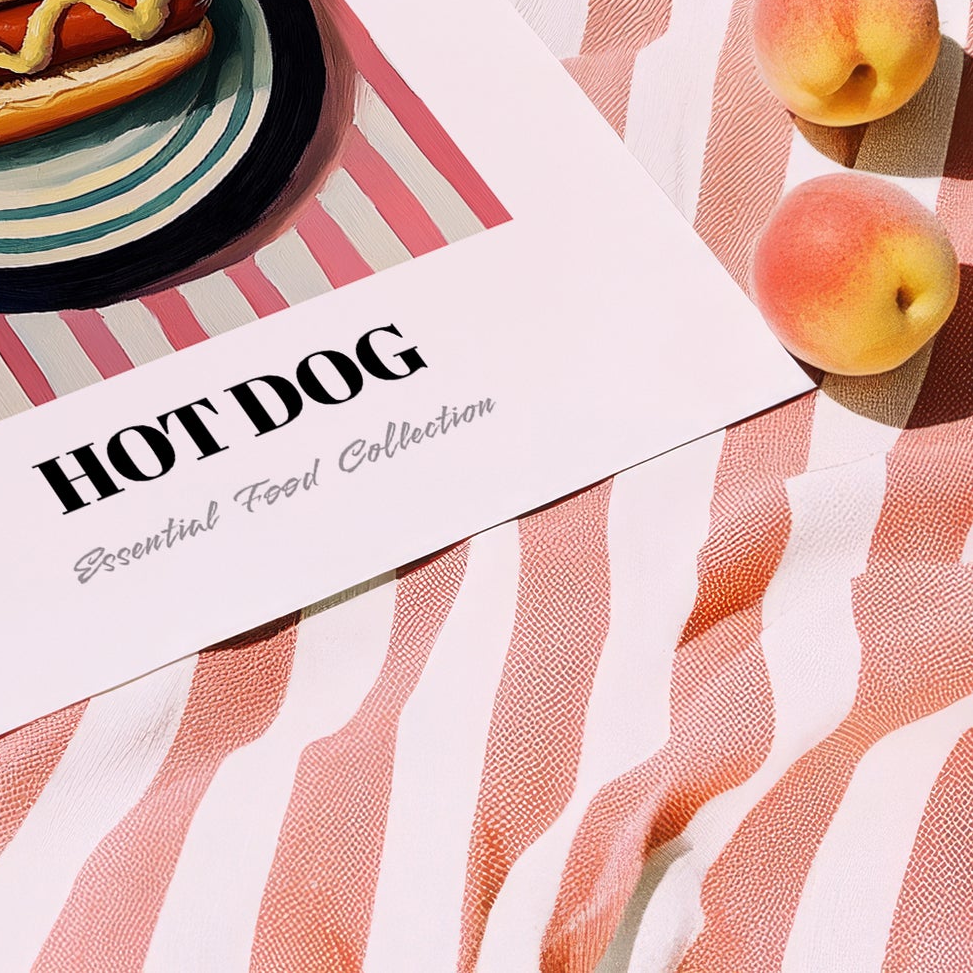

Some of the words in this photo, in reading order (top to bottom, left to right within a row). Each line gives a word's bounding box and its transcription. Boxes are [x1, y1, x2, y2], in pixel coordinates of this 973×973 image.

[31, 397, 230, 515] HOT
[223, 323, 429, 437] DOG
[73, 499, 220, 584] Essential
[232, 458, 321, 513] Food
[338, 398, 496, 474] Collection
